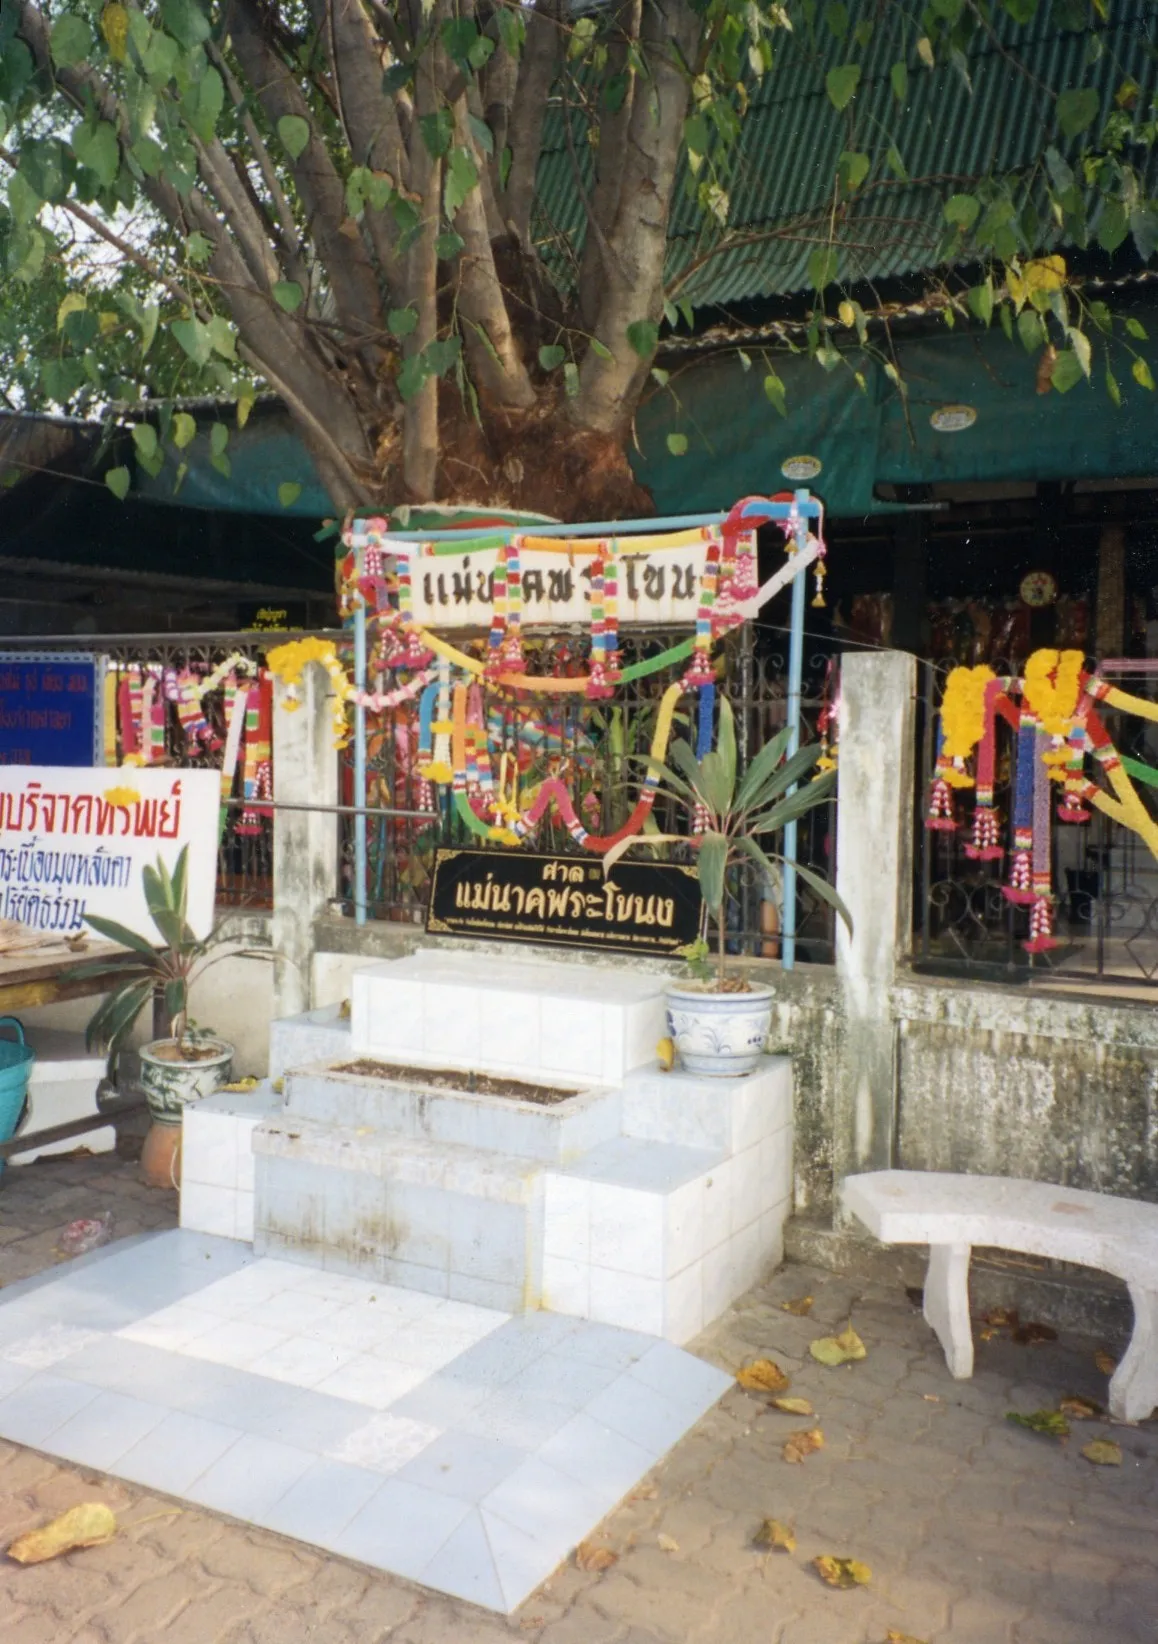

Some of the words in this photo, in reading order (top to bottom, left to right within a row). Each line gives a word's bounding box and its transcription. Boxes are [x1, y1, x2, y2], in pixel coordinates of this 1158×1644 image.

[423, 553, 701, 605] แม่นคพโขน
[0, 779, 182, 838] บริจาคทรพย์
[542, 861, 585, 883] ศาล
[455, 872, 674, 928] แม่นาคพระโขนง
